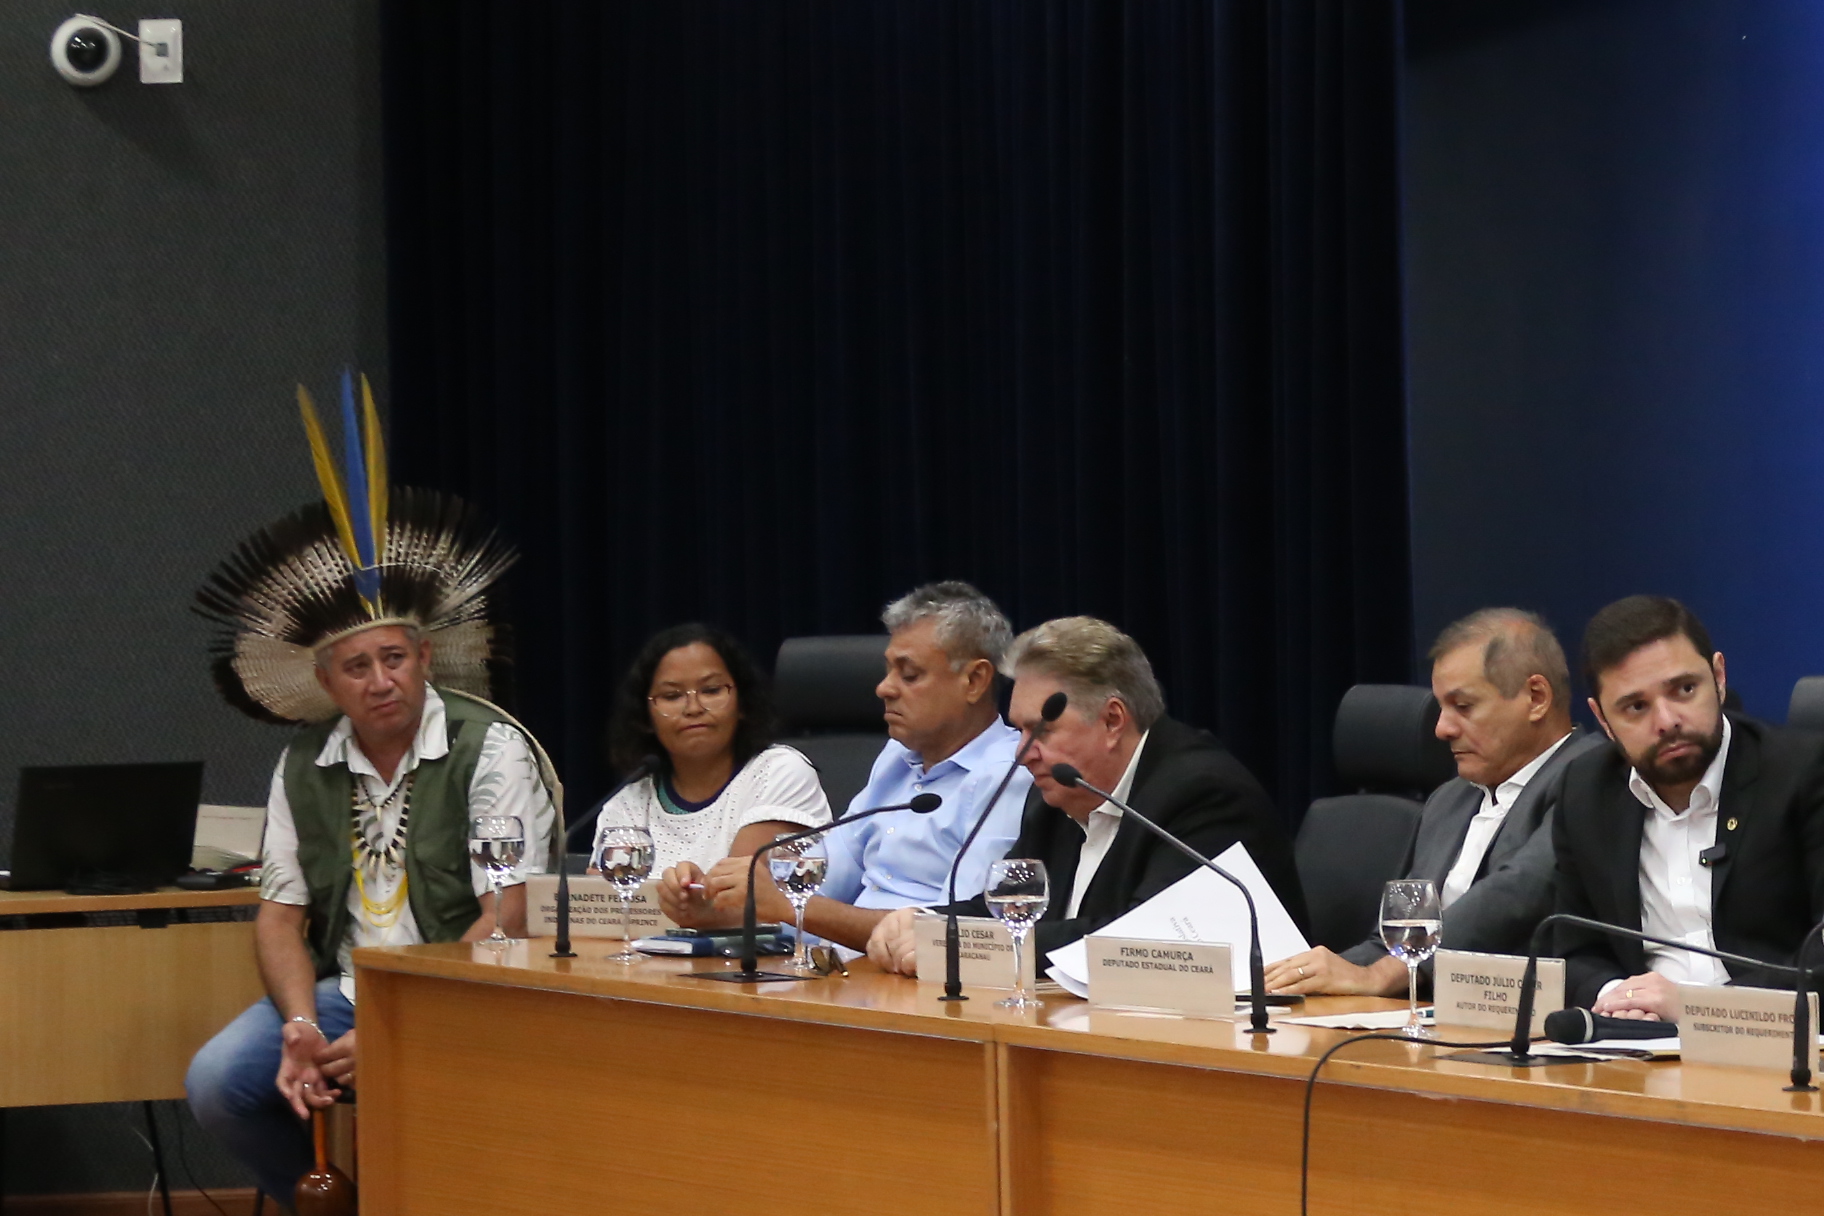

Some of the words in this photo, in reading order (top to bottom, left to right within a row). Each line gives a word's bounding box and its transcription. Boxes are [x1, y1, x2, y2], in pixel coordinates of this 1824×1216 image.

[586, 917, 596, 925] DO
[1120, 947, 1149, 958] FIRMO
[1151, 949, 1194, 962] CAMURÇA
[1102, 959, 1140, 969] DEPUTADO
[1141, 962, 1177, 972] ESTADUAL
[1180, 964, 1189, 973] DO
[1450, 973, 1491, 986] DEPUTADO
[1484, 990, 1507, 1001] FILHO
[1457, 1002, 1476, 1010] AUTOR
[1478, 1004, 1487, 1012] DO
[1685, 1005, 1728, 1018] DEPUTADO
[1730, 1009, 1776, 1022] LUCINILDO
[1693, 1023, 1733, 1034] SUBSCRITOR
[1735, 1026, 1745, 1035] DO
[1747, 1027, 1795, 1038] REQUERIMENT
